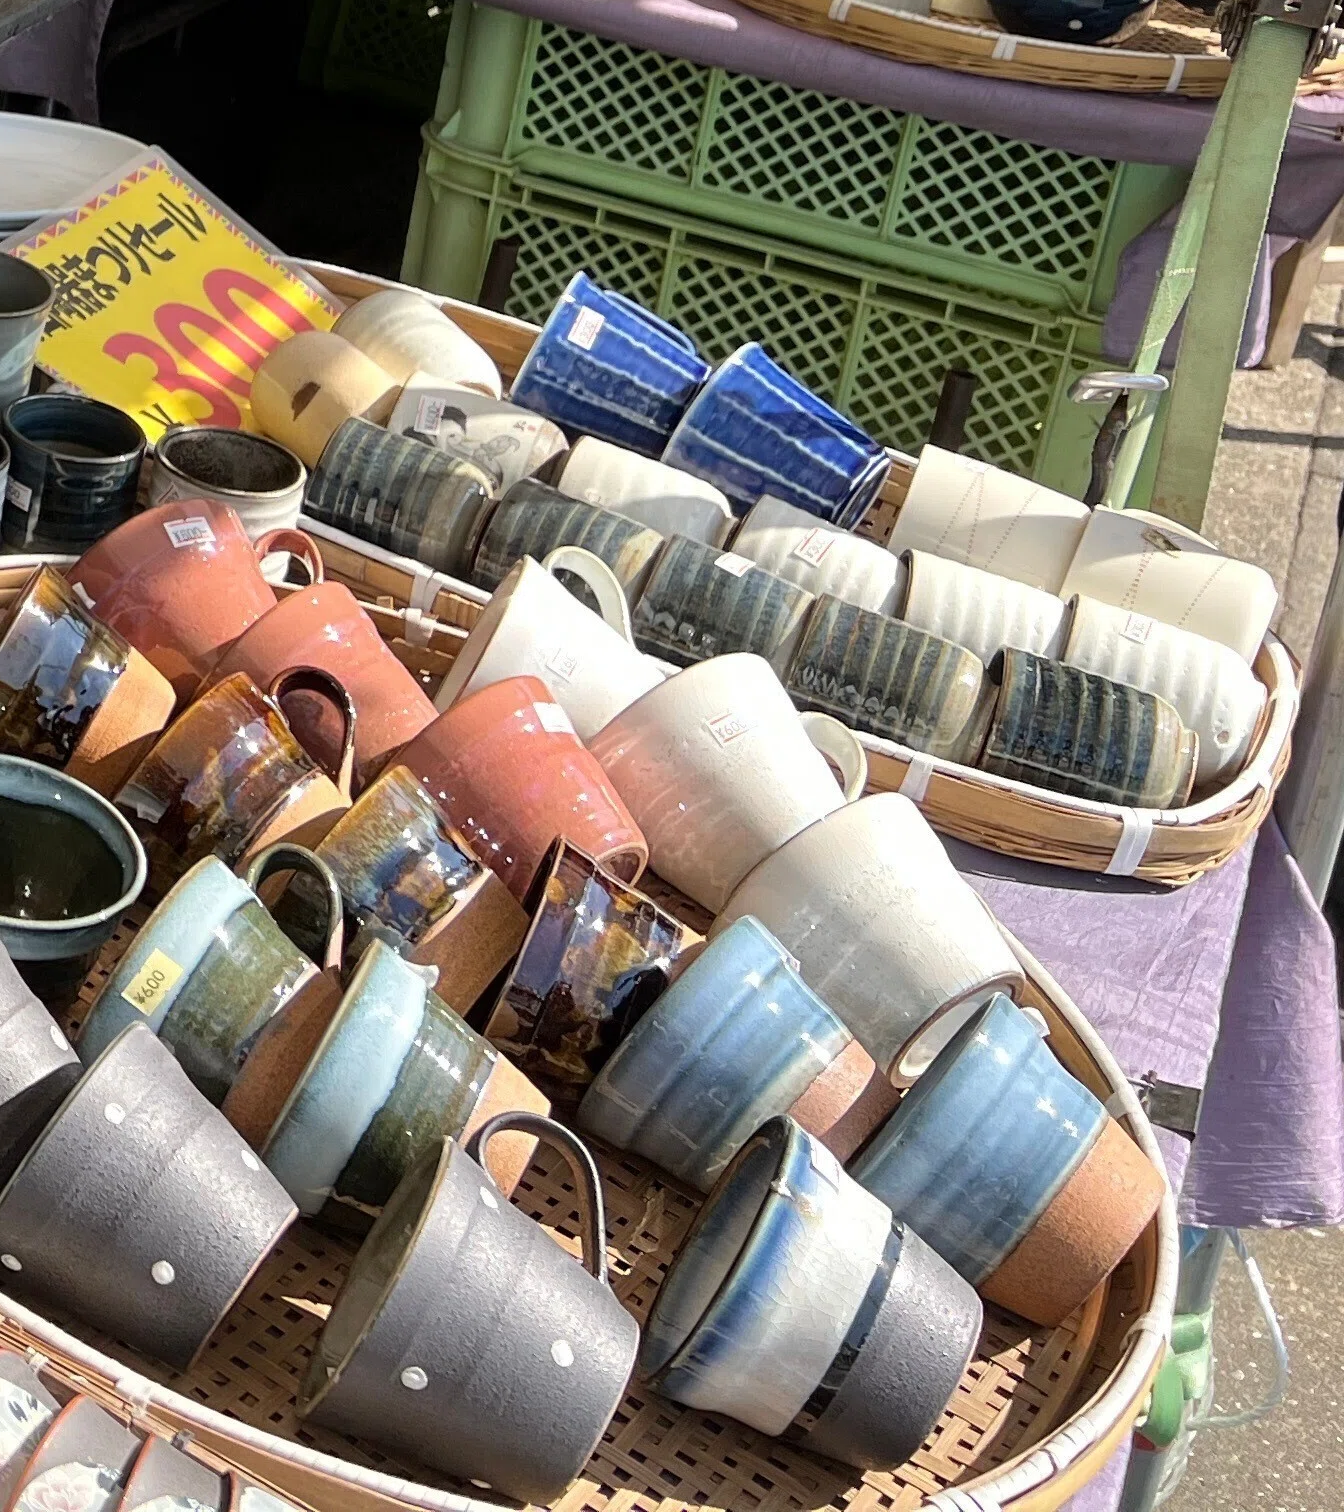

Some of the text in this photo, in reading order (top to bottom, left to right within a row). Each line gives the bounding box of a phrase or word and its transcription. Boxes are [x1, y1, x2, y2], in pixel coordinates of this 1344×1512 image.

[40, 192, 208, 342] 器まつりセール
[133, 969, 166, 1006] ¥600
